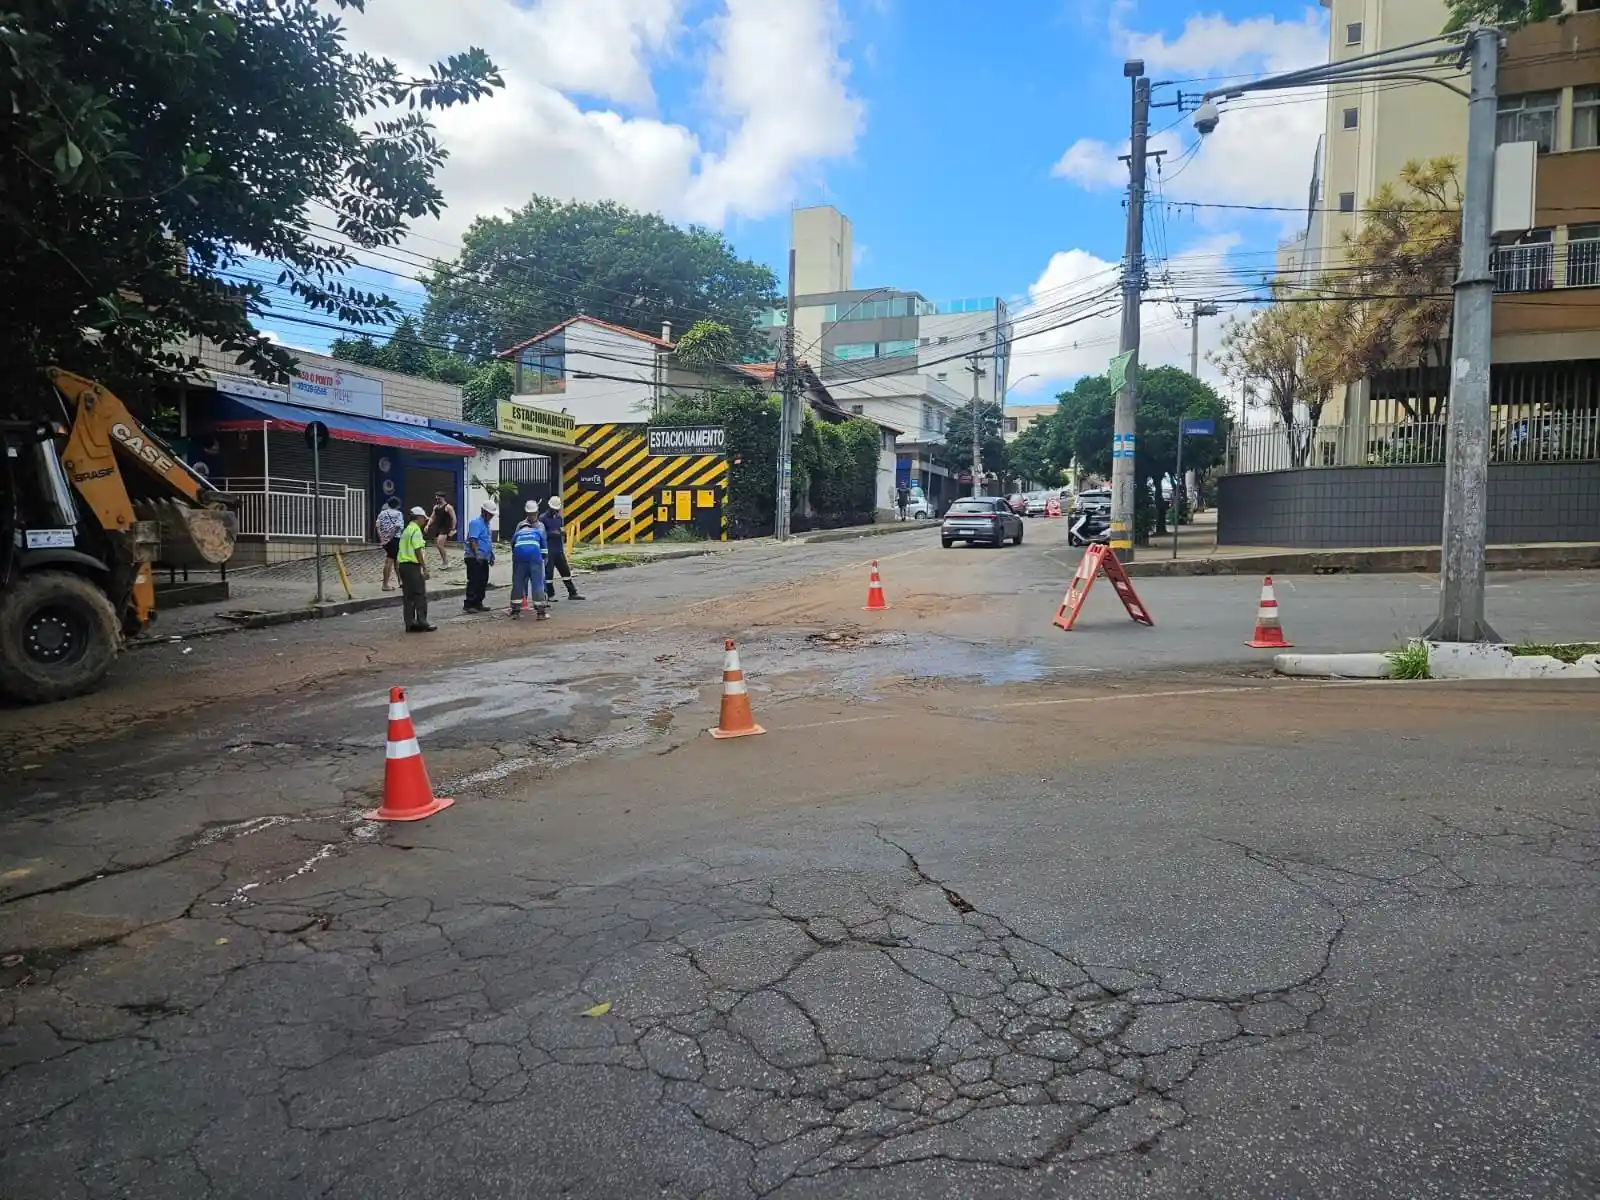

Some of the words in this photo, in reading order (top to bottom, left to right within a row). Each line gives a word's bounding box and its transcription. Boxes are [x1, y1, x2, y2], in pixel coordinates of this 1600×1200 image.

[512, 406, 575, 430] ESTACIONAMENTO
[111, 422, 174, 475] CASE
[650, 429, 724, 448] ESTACIONAMENTO
